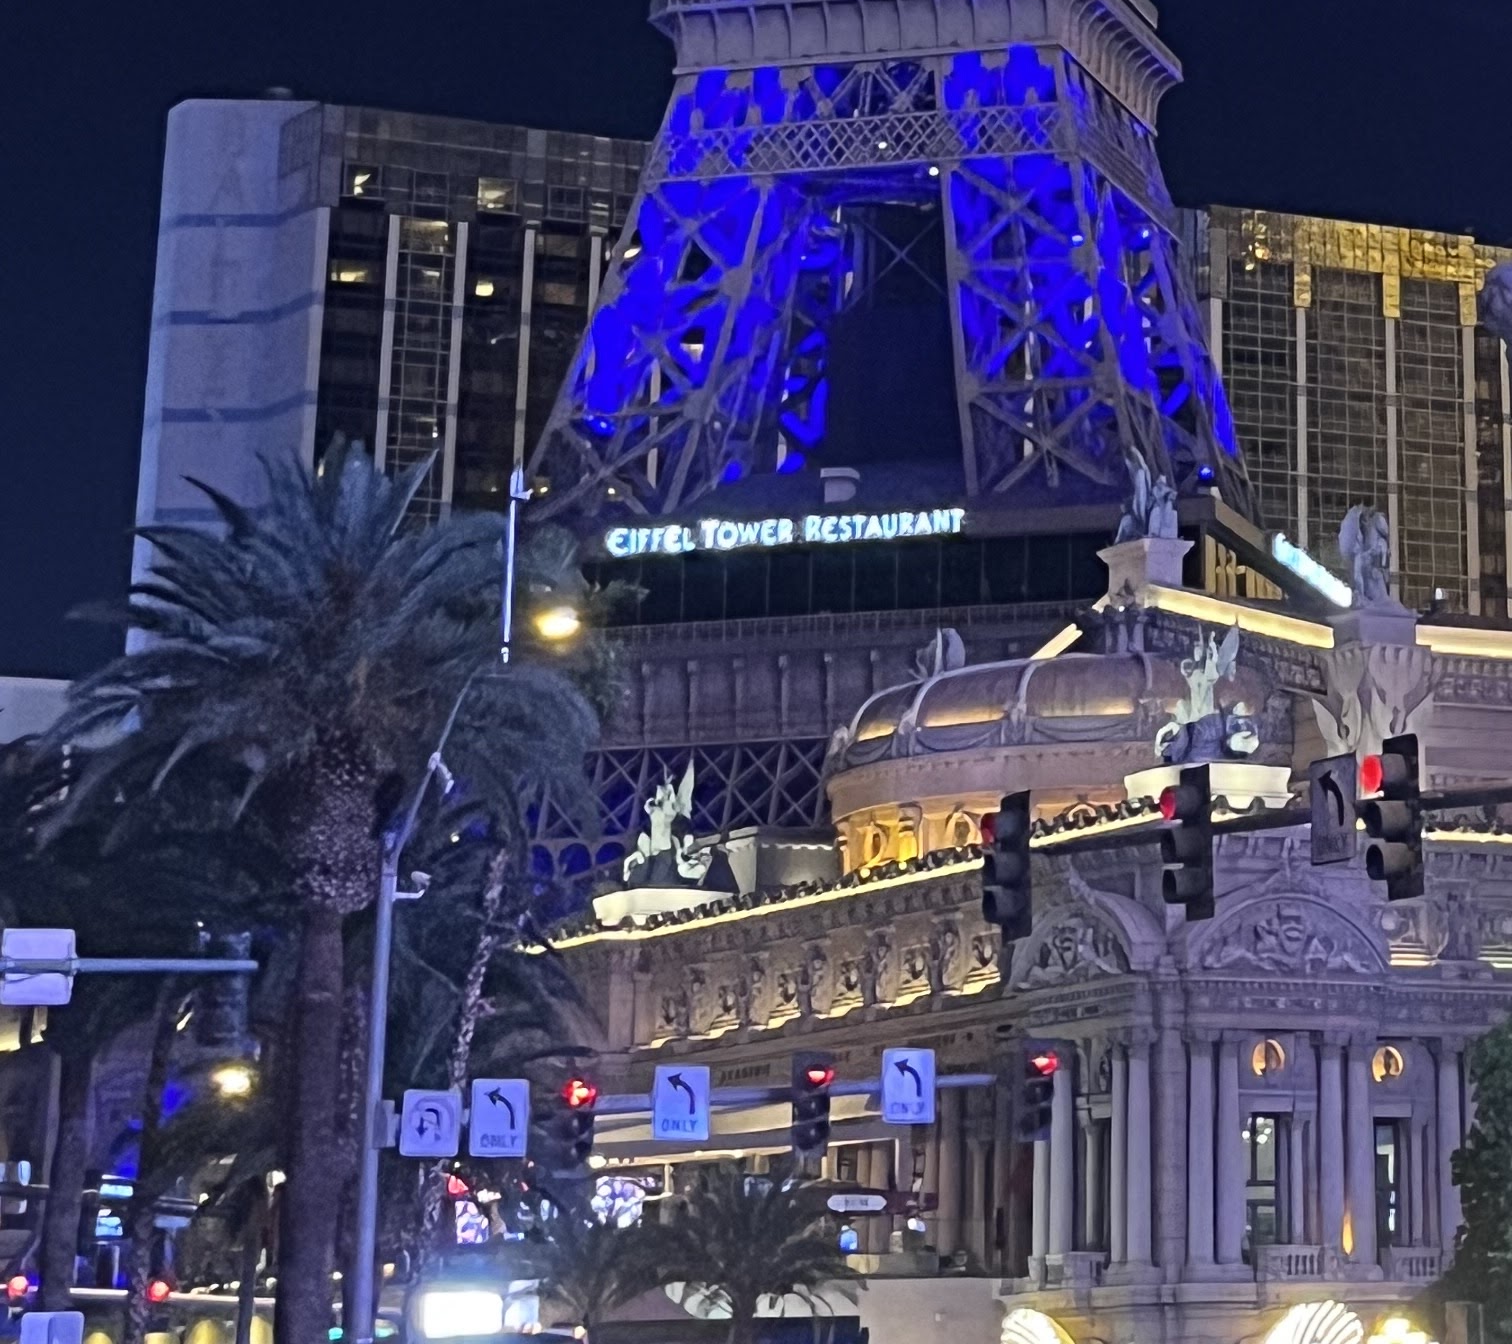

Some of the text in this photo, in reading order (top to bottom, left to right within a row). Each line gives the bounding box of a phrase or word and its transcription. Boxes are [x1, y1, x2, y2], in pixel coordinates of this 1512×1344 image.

[606, 509, 965, 556] EIFFEL TOWER RESTAURANT
[661, 1118, 698, 1132] ONLY
